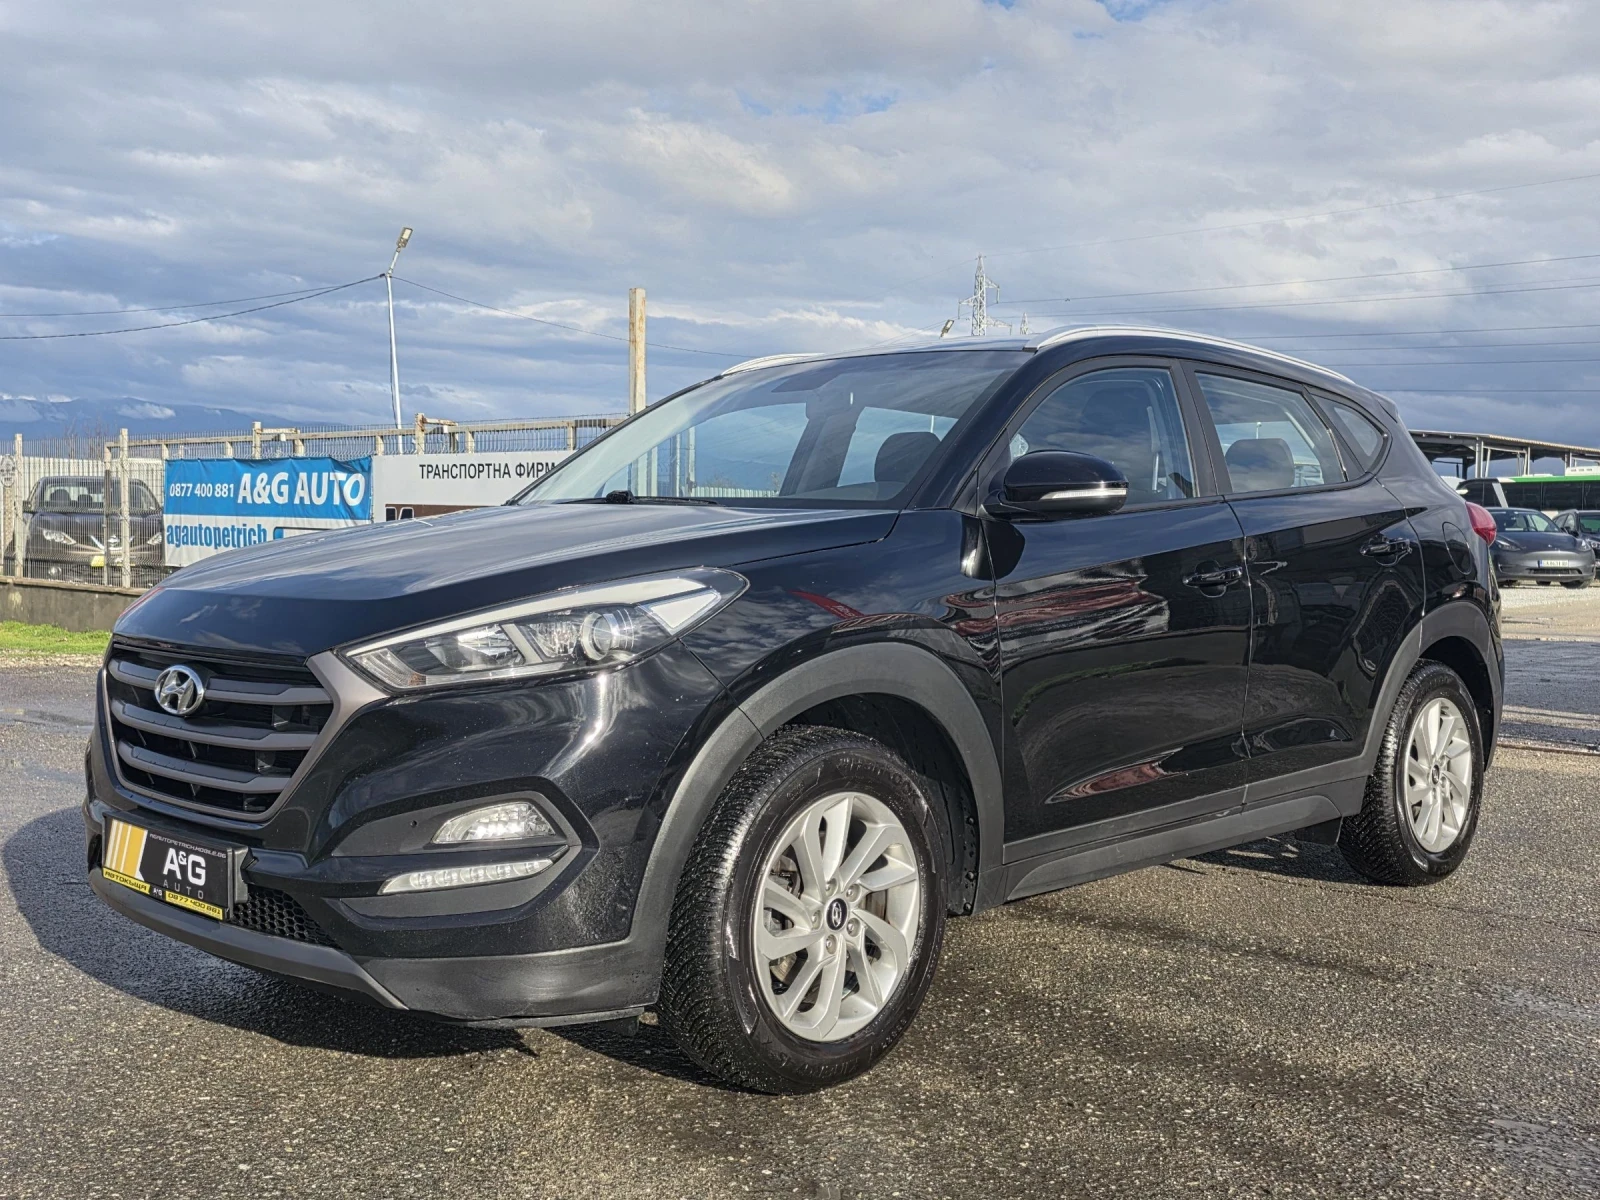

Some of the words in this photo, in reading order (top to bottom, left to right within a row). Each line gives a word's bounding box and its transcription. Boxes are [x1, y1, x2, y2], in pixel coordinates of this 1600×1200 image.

[419, 463, 511, 479] ТРАНСПОРТНА
[169, 483, 193, 497] 0877
[194, 483, 213, 497] 400
[215, 483, 235, 498] 881
[237, 472, 289, 504] A&G
[294, 472, 366, 506] AUTO
[166, 523, 268, 549] agautopetrich
[163, 847, 206, 886] A&G
[163, 879, 204, 900] AUTO
[168, 892, 189, 903] 0877
